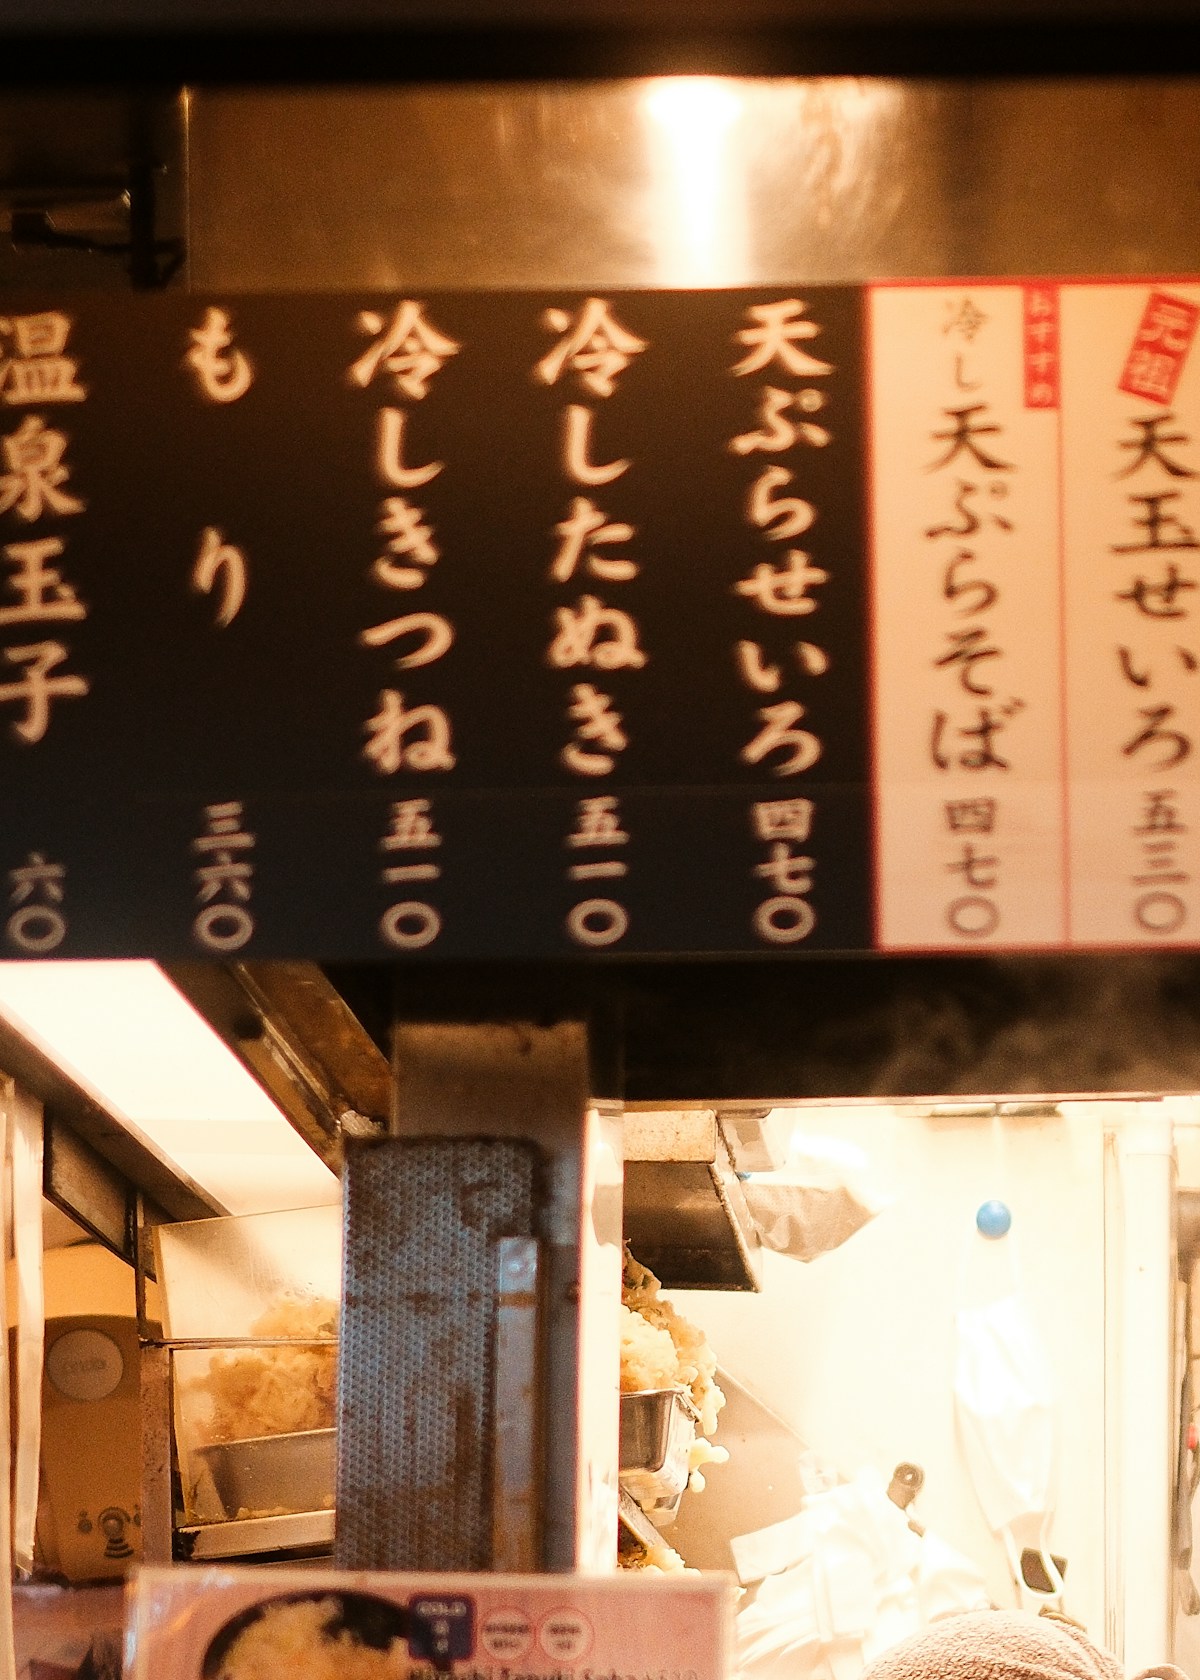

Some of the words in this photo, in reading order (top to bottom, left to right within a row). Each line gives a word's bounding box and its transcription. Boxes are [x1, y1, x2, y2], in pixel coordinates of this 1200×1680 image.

[0, 311, 88, 743] 温泉玉子
[186, 306, 254, 627] もり
[350, 299, 459, 772] 冷しきつね
[536, 296, 647, 774] 冷したぬき
[730, 299, 832, 776] 天ぷらせいろ
